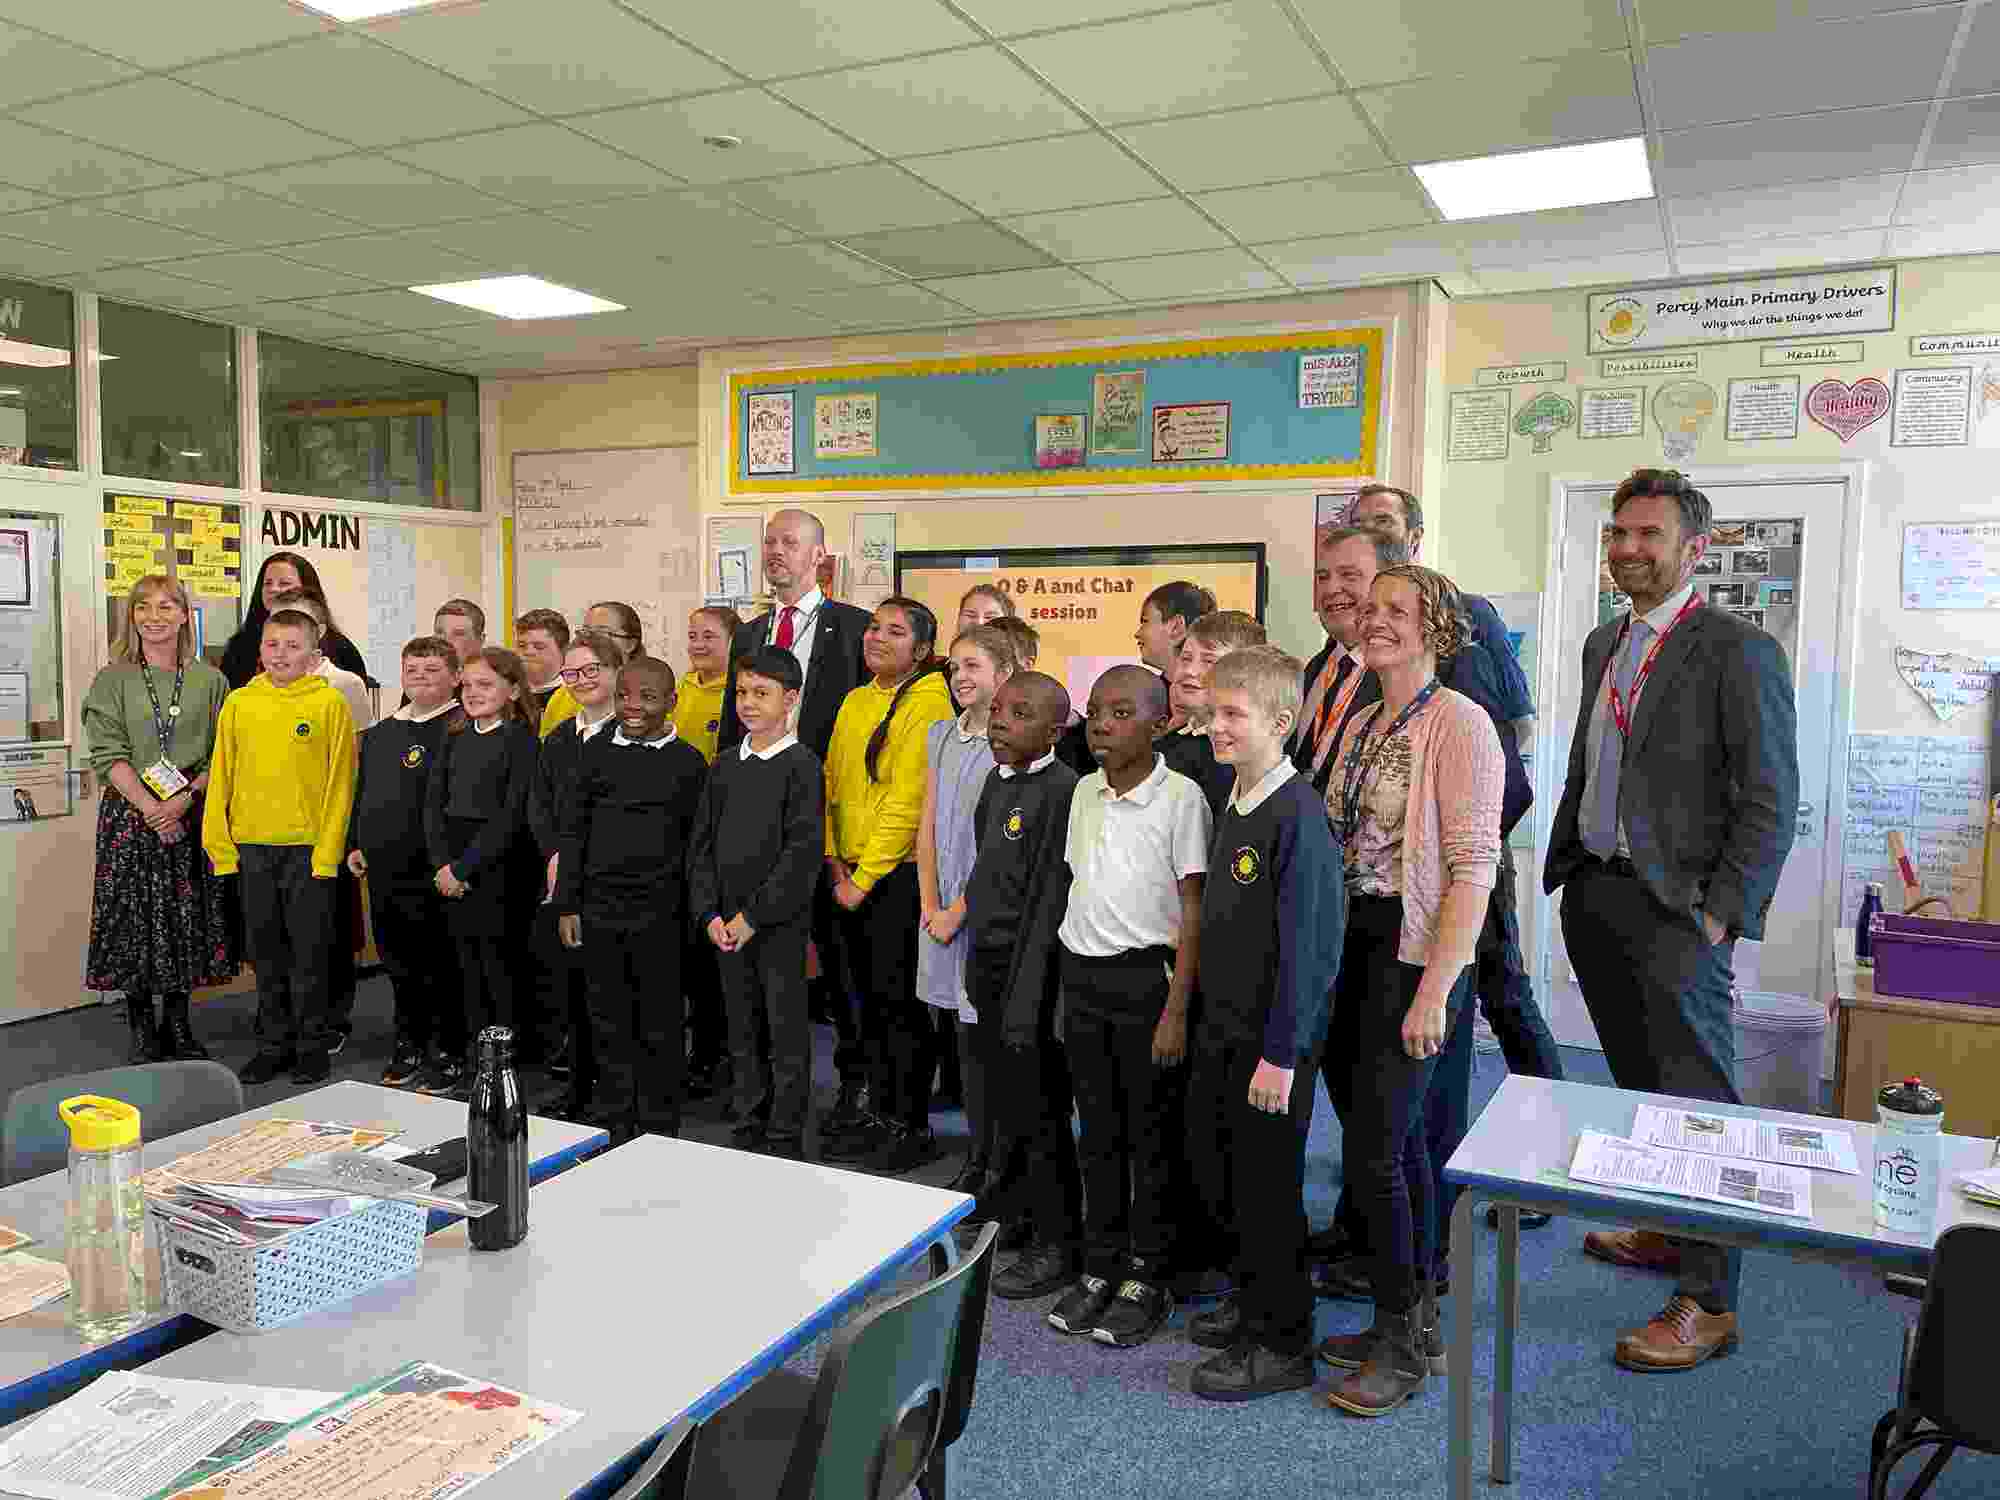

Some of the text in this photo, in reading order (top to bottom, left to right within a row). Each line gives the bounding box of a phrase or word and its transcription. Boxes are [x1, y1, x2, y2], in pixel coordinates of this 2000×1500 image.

[1655, 284, 1885, 315] Percy Main Primary Drivers
[1701, 318, 1726, 331] Why
[1728, 319, 1745, 328] we
[1748, 316, 1762, 327] do
[1766, 314, 1782, 325] the
[1785, 311, 1821, 325] things
[1824, 312, 1844, 322] we
[1785, 350, 1835, 361] Health
[1606, 359, 1697, 373] Possibilities
[1496, 367, 1544, 381] Growth
[1302, 392, 1358, 405] TRYIN
[261, 509, 360, 551] ADMIN
[1016, 578, 1030, 593] &
[1034, 578, 1046, 593] A
[1052, 578, 1086, 593] and
[1091, 577, 1134, 593] Chat
[1030, 604, 1098, 619] session
